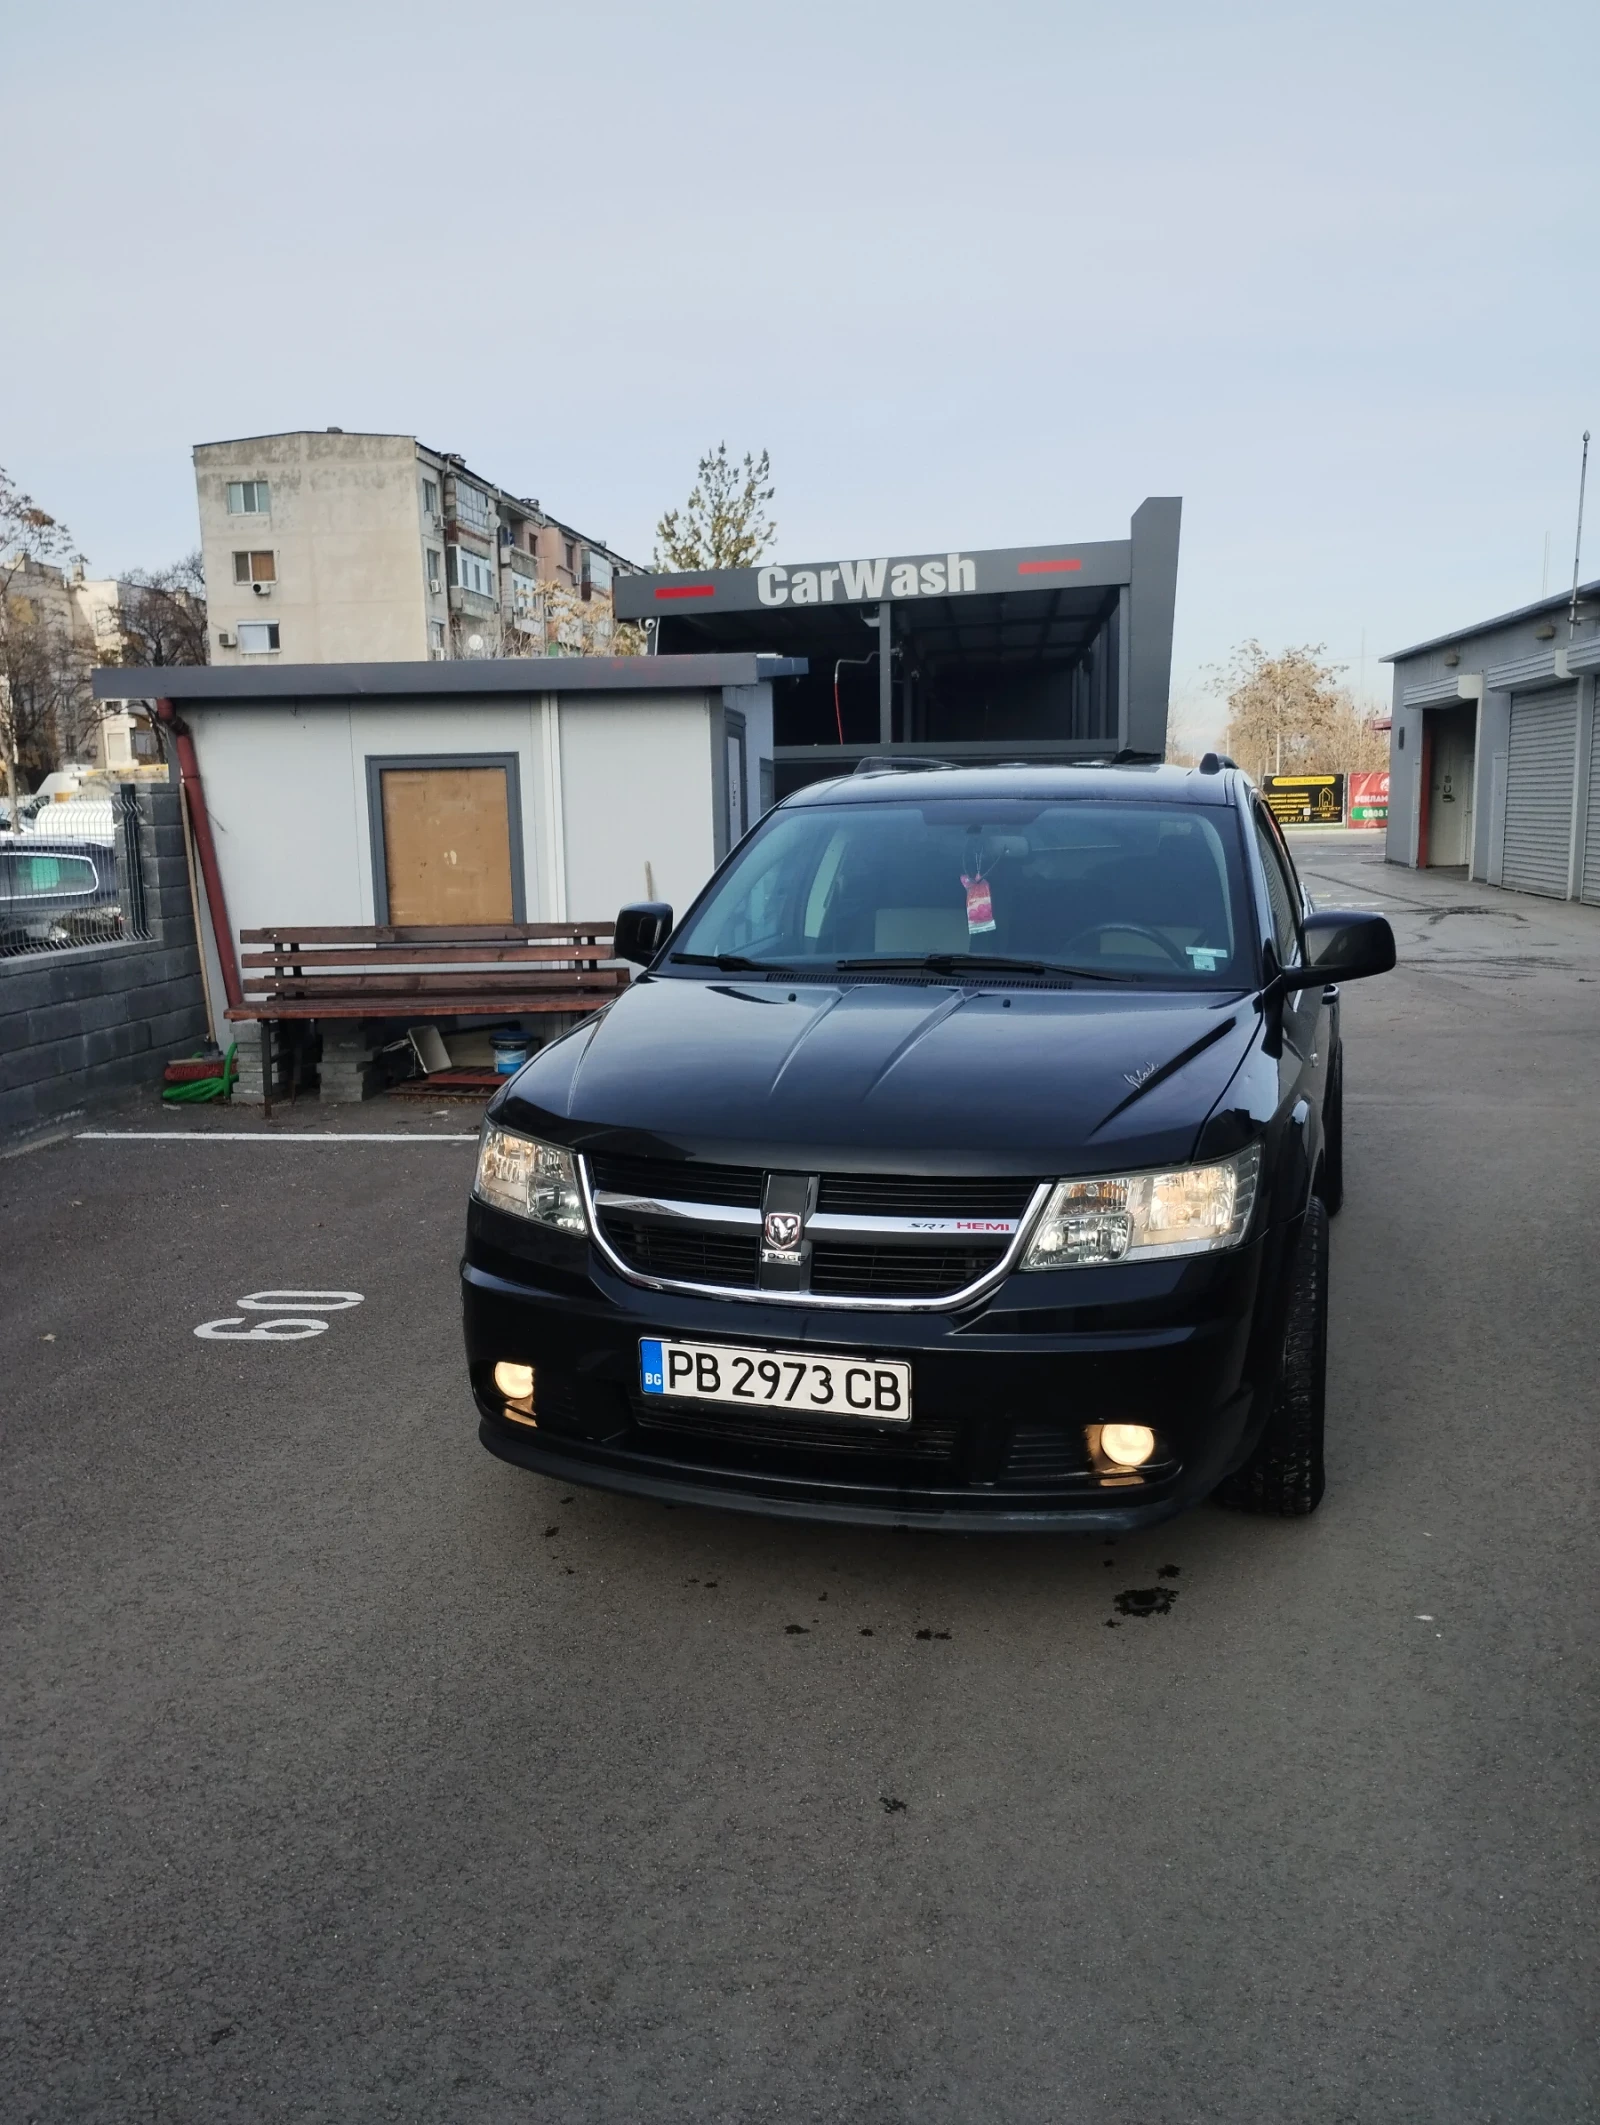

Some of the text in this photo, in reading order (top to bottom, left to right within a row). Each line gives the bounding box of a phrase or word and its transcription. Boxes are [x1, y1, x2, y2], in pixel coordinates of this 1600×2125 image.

[757, 553, 976, 606] CarWash
[957, 1222, 1009, 1231] HEMI
[645, 1372, 662, 1386] BG
[668, 1350, 901, 1412] PB 2973 CB
